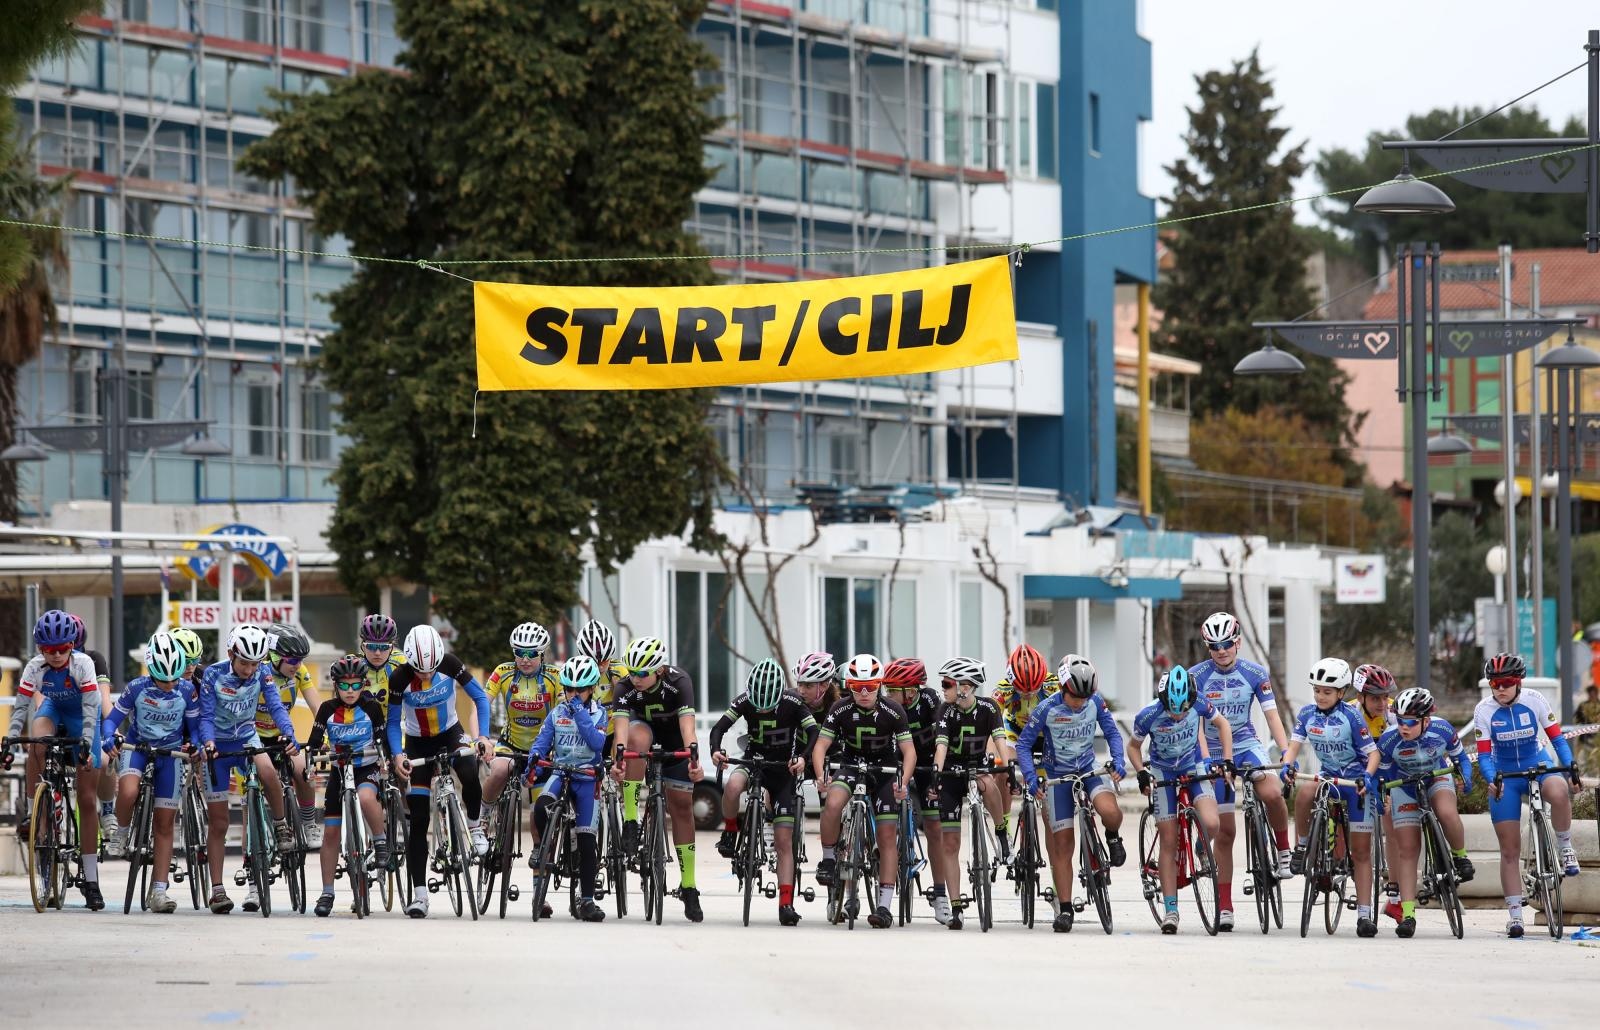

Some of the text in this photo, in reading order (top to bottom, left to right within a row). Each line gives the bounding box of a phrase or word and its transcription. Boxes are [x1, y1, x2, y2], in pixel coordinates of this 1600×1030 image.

[519, 283, 972, 367] START/CILJ
[183, 607, 293, 623] RESURANT
[1240, 661, 1265, 680] Bianchi
[143, 711, 178, 721] ZADAR
[1057, 726, 1092, 739] ZADAR
[1160, 728, 1194, 745] ZADAR
[557, 734, 587, 746] ZADA
[1314, 741, 1349, 753] ZADAR
